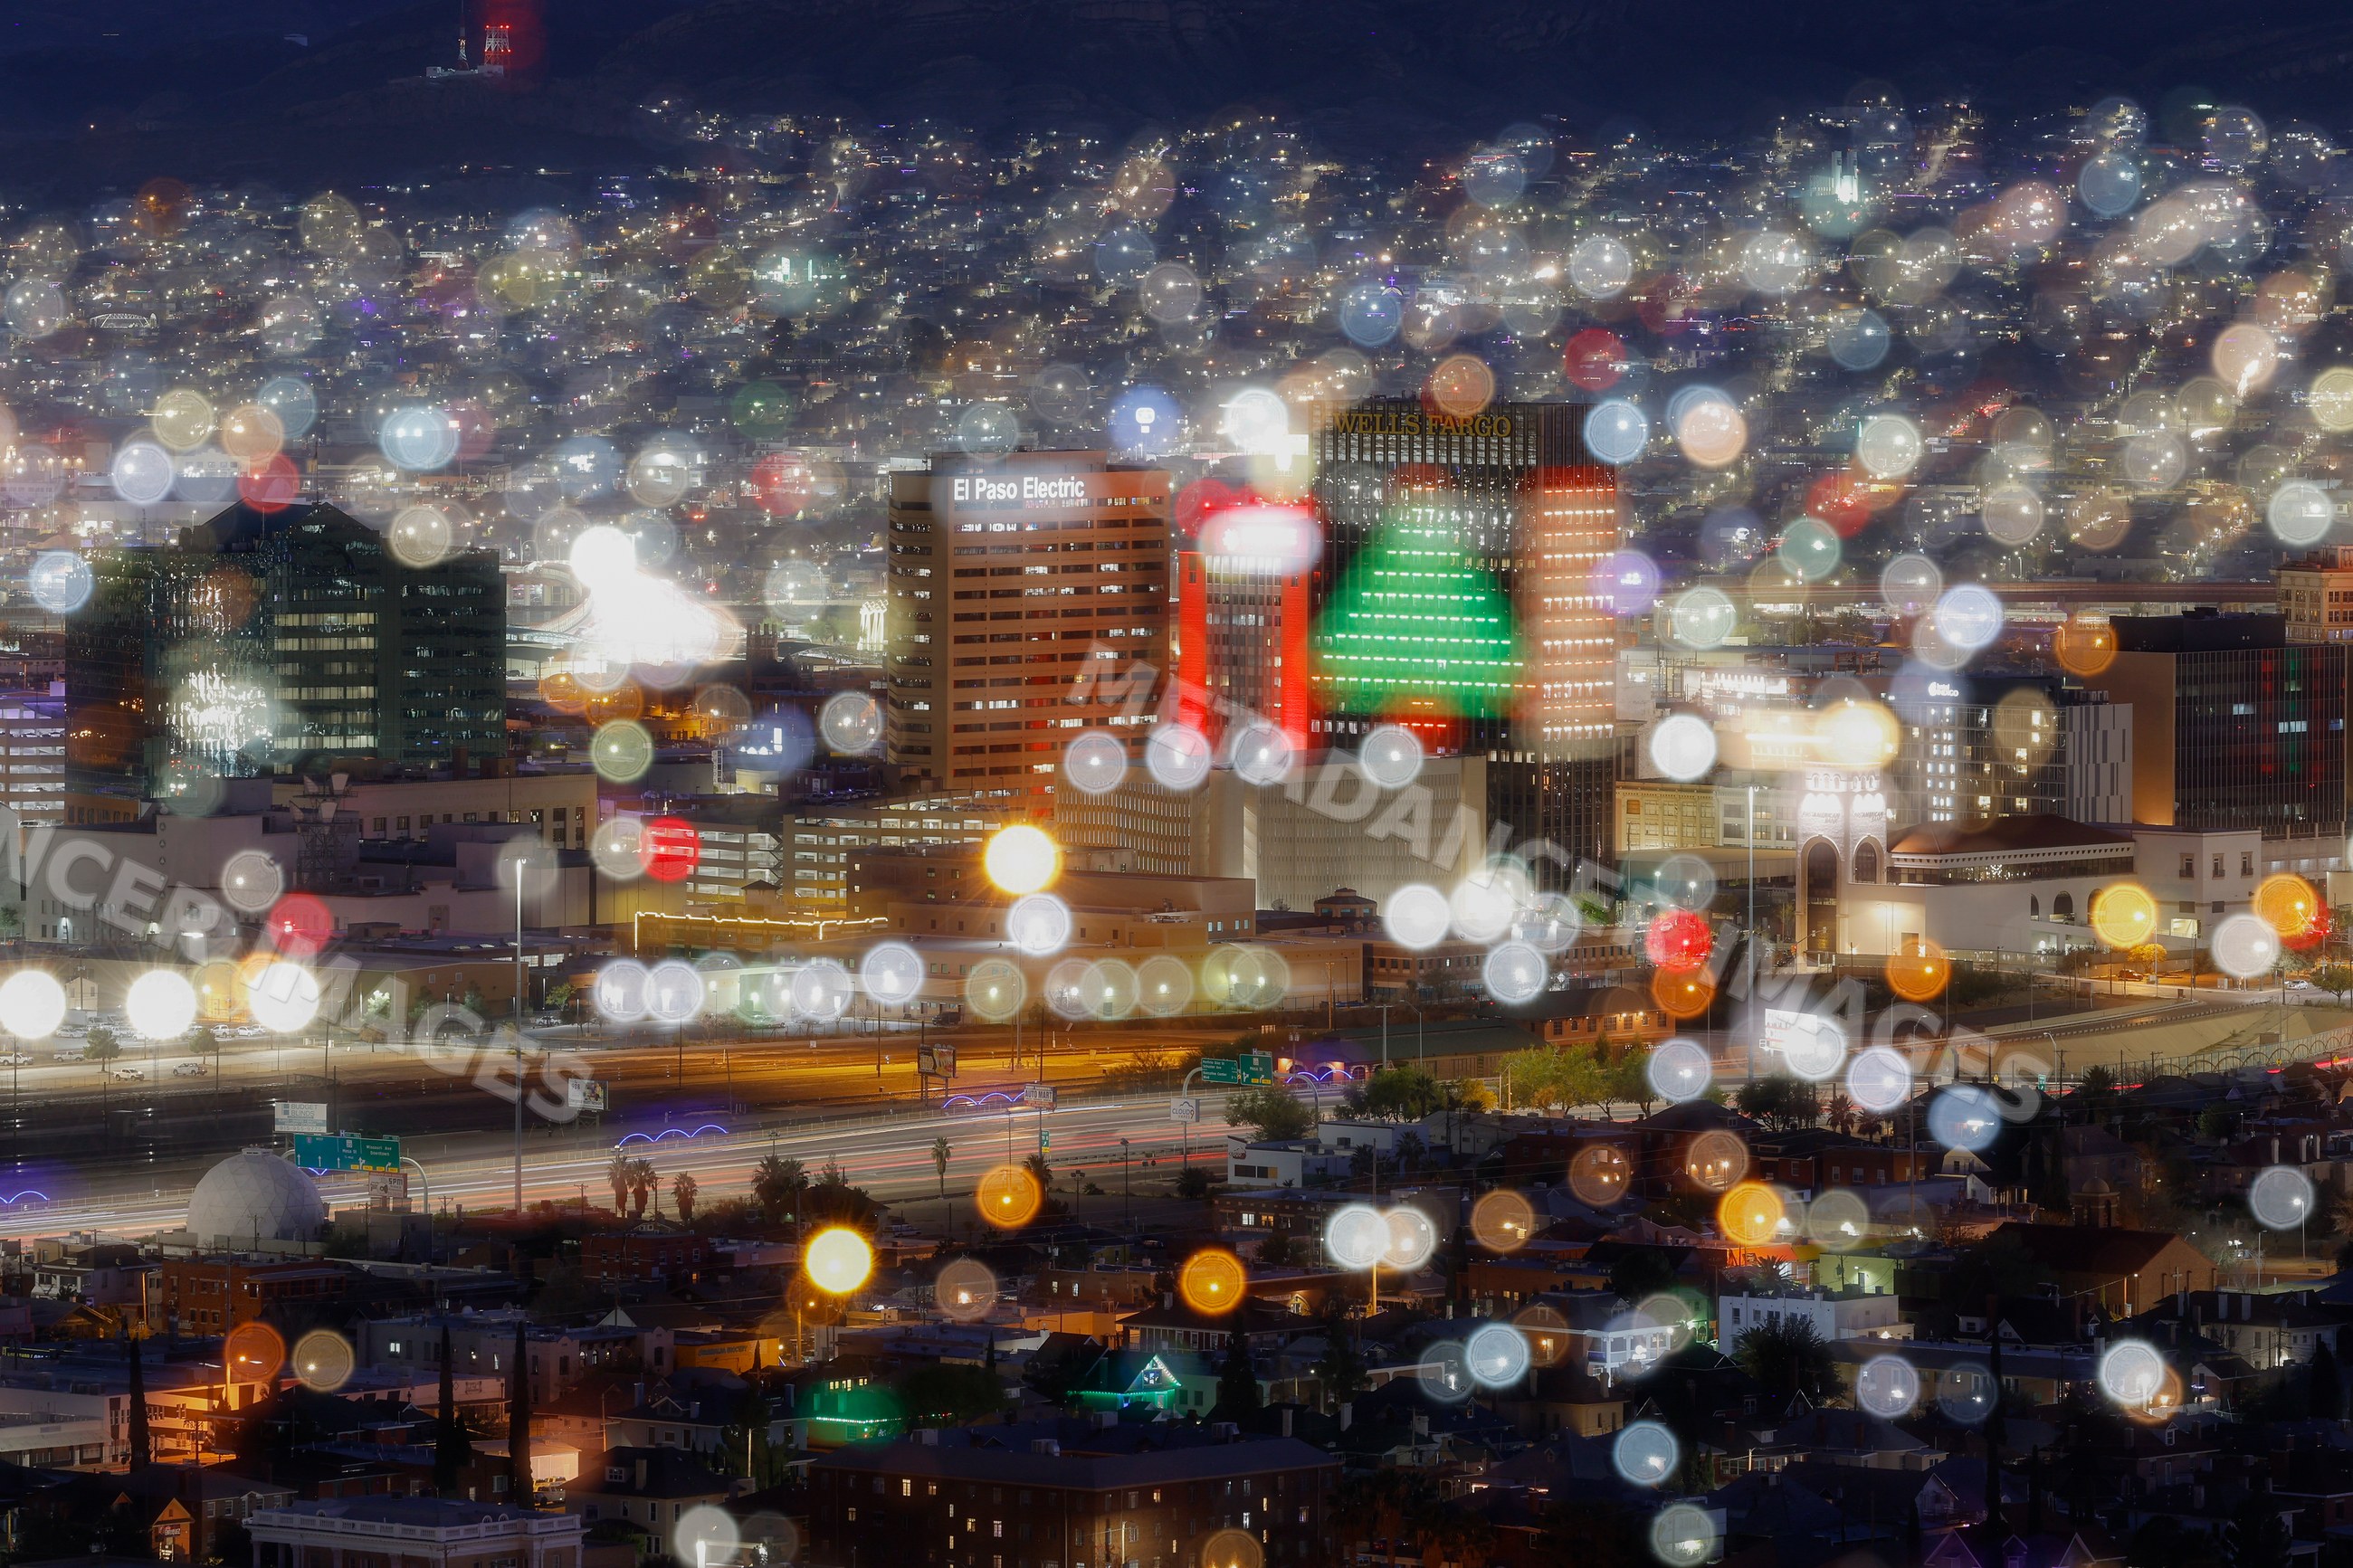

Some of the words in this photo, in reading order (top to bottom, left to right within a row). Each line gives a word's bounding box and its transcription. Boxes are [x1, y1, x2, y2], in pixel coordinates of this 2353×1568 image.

[1333, 413, 1421, 435] WELLS
[1426, 414, 1512, 438] FARGO
[954, 479, 969, 500] El
[975, 478, 1018, 500] Paso
[1023, 476, 1085, 499] Electric
[1025, 1090, 1038, 1098] AUTO
[1038, 1090, 1053, 1100] MART
